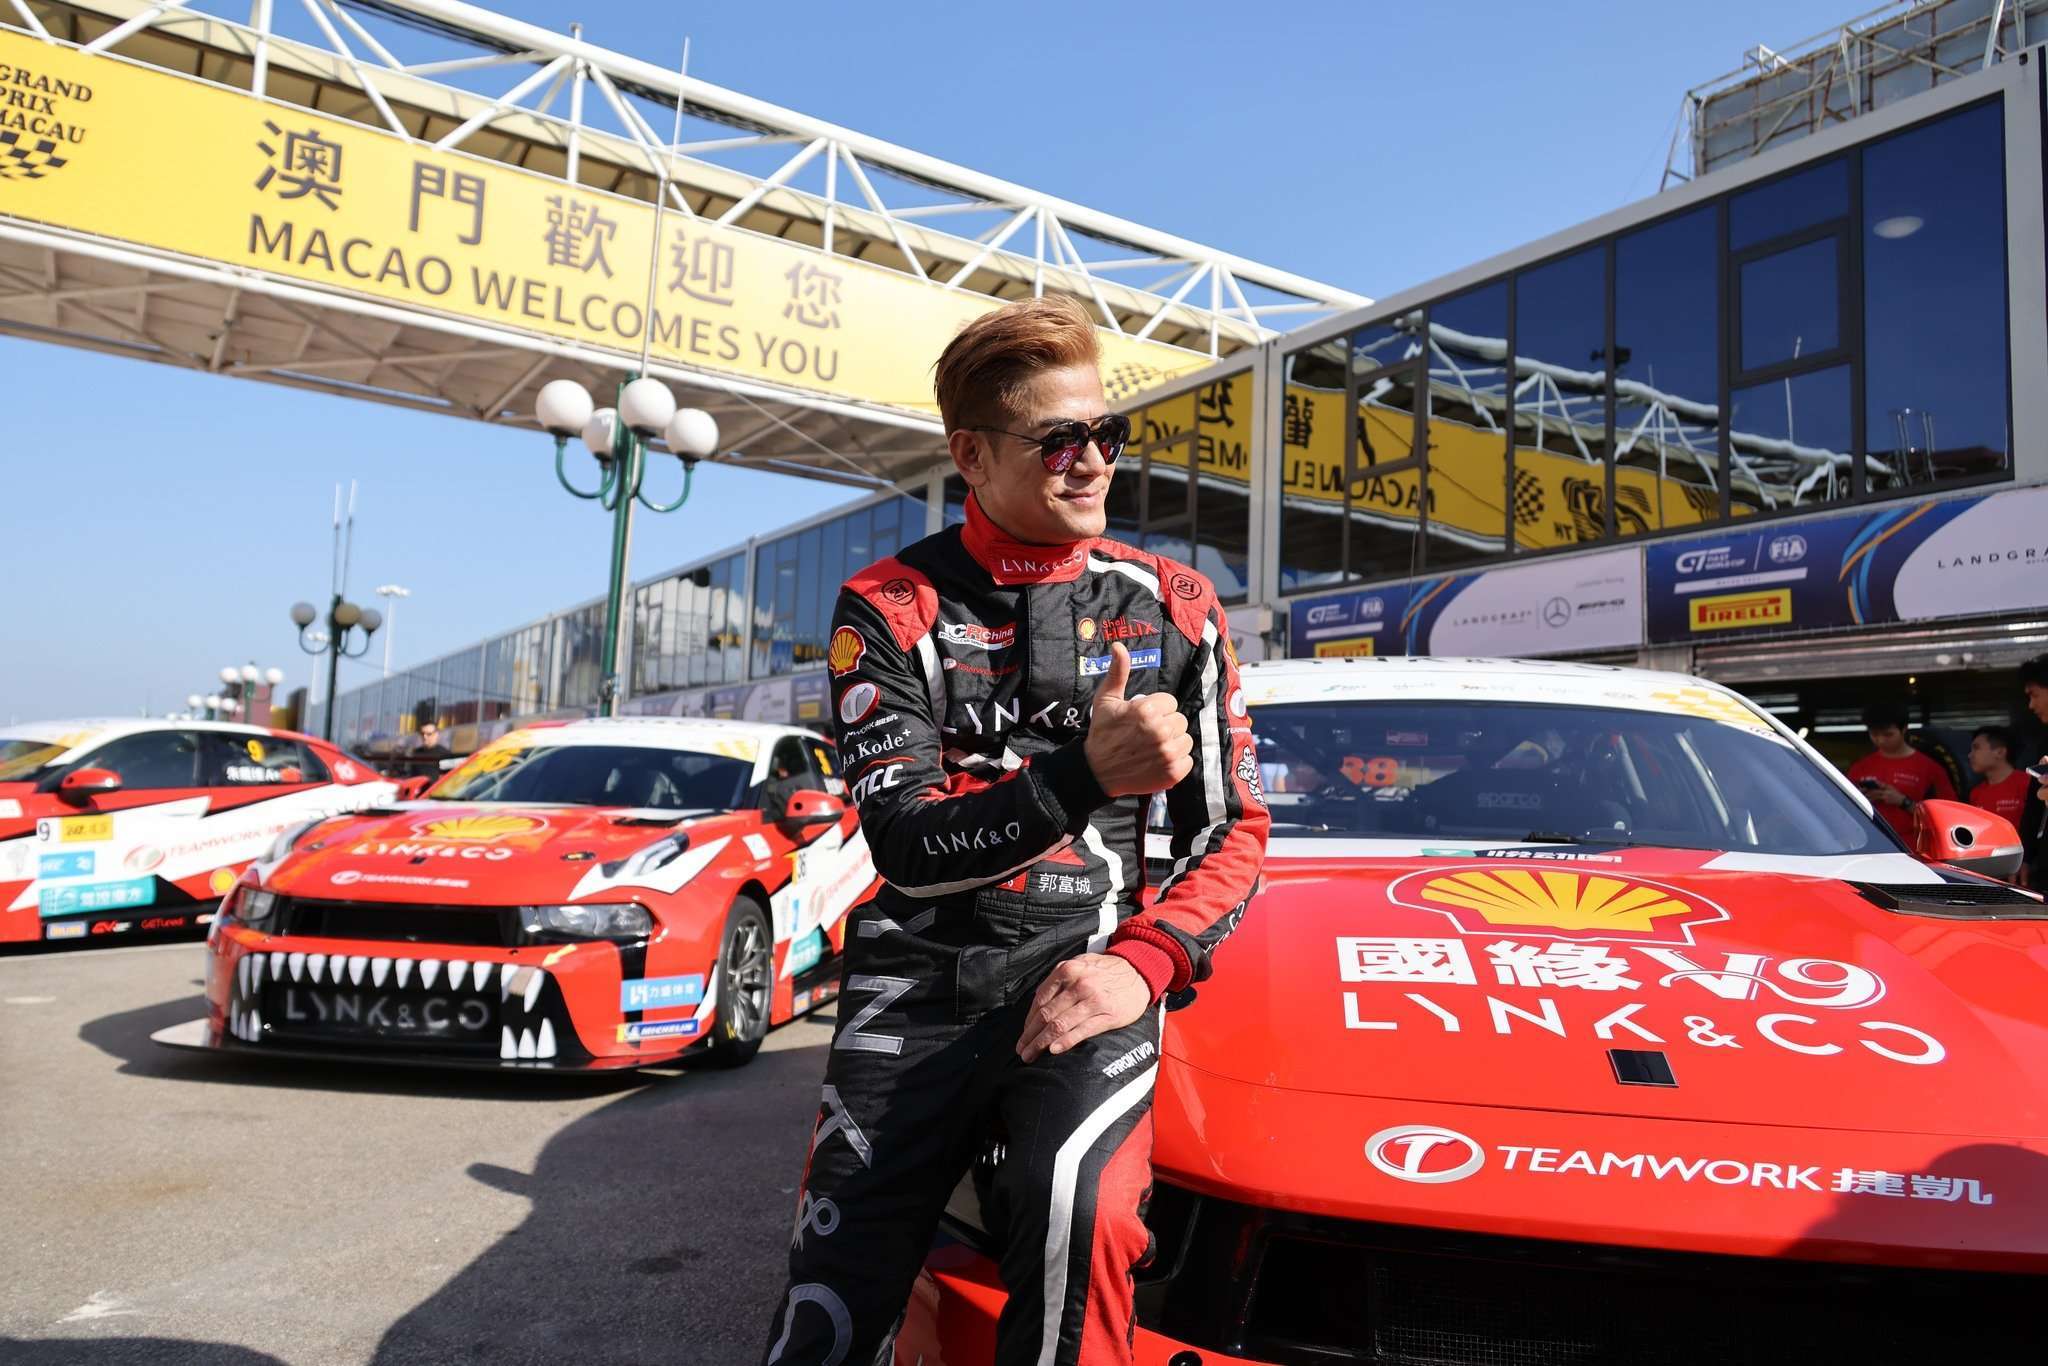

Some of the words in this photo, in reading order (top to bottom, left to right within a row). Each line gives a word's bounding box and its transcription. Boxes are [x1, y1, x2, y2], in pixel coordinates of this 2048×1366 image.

[0, 64, 93, 102] GRAND
[255, 119, 843, 332] 澳門歡迎您
[248, 213, 453, 296] MACAO
[471, 265, 741, 361] WELCOMES
[754, 338, 840, 382] YOU
[1771, 539, 1804, 559] FIA
[1937, 546, 2048, 569] LANDGRA
[1102, 615, 1126, 628] Shell
[1698, 596, 1781, 624] PIRELLI
[1104, 623, 1153, 640] HELIX
[1102, 654, 1157, 669] MELIN
[247, 739, 264, 763] 9
[38, 821, 50, 842] 9
[1039, 872, 1093, 895] 郭富城
[1336, 936, 1644, 990] 國緣
[640, 1023, 694, 1036] MICHELIN
[1497, 1145, 1822, 1191] TEAMWORK
[1830, 1168, 1993, 1205] 捷凱
